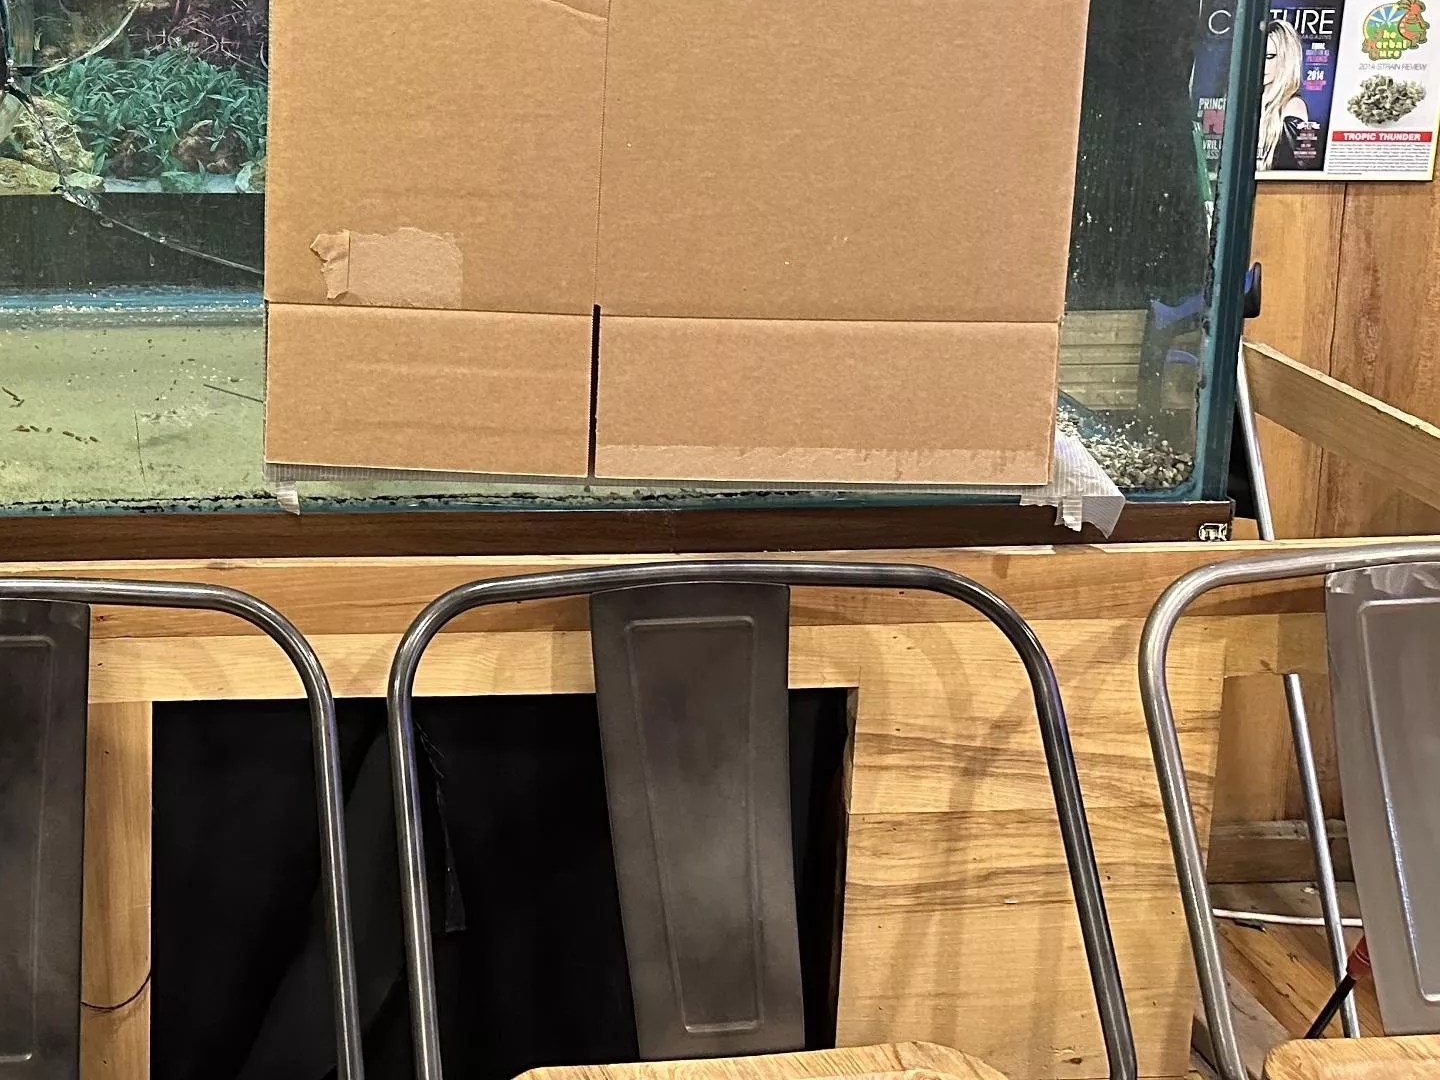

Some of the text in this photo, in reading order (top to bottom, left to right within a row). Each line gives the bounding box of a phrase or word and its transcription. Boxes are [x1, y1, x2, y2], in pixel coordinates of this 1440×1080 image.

[1377, 63, 1401, 71] STRAIN
[1401, 63, 1428, 71] REVIEW
[1306, 69, 1325, 81] 2014
[1343, 132, 1422, 142] TROPIC THUNDER
